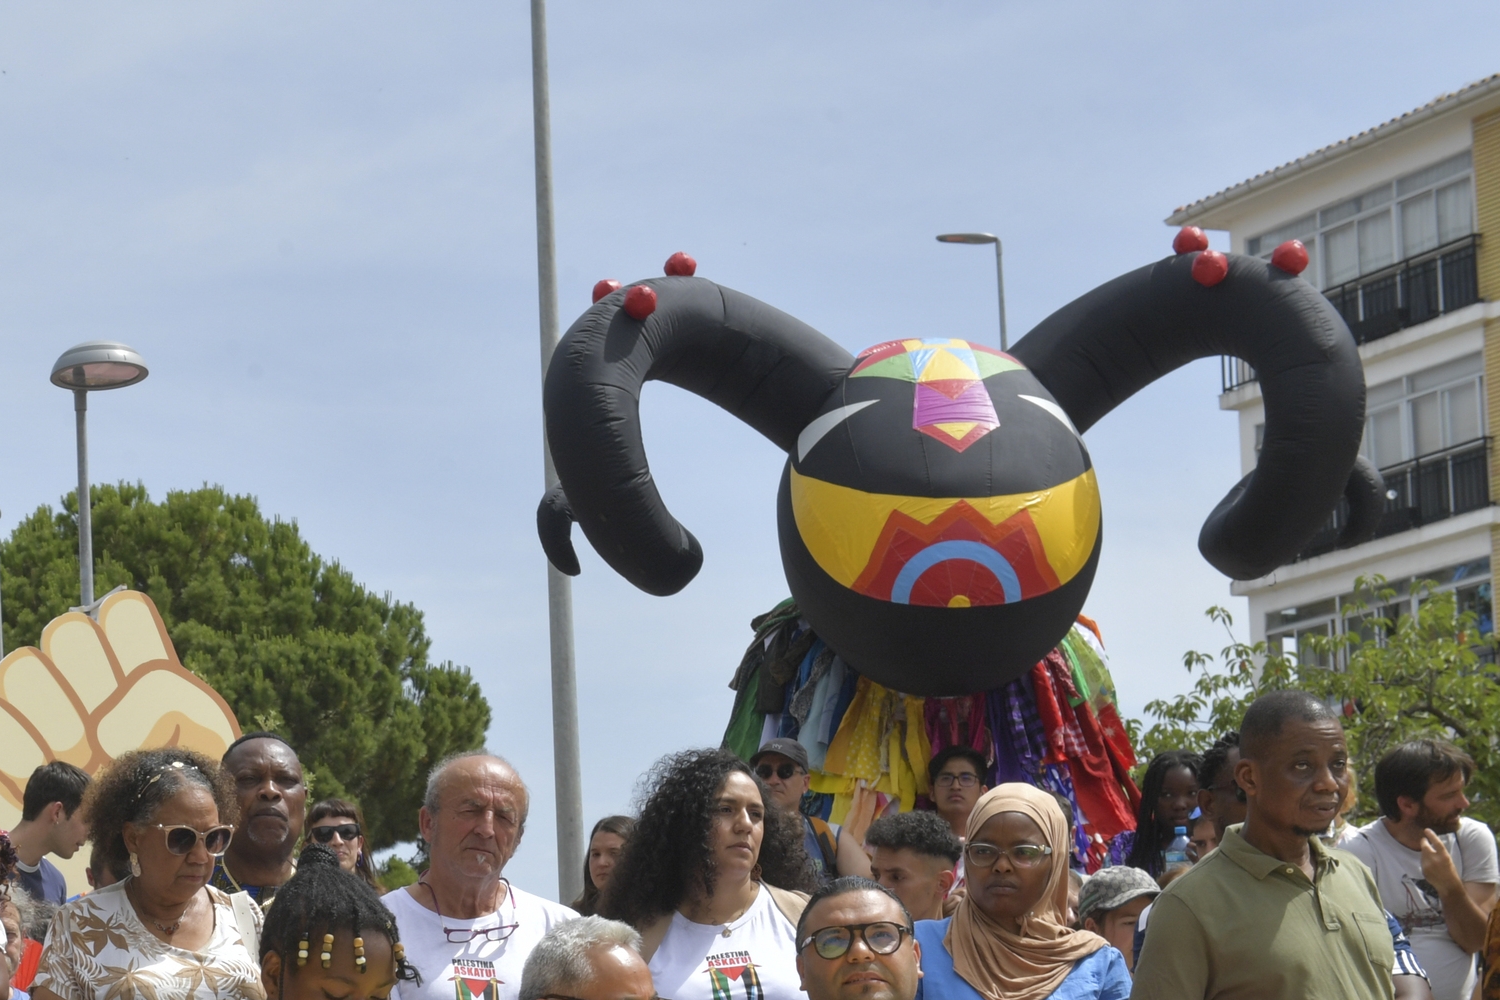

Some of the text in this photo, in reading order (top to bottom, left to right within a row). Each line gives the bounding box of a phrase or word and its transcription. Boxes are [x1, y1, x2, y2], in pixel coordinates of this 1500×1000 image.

[706, 950, 749, 961] PALESTINA
[452, 958, 494, 969] PALESTINA
[708, 956, 752, 967] ASKATU!
[454, 966, 496, 978] ASKATU!
